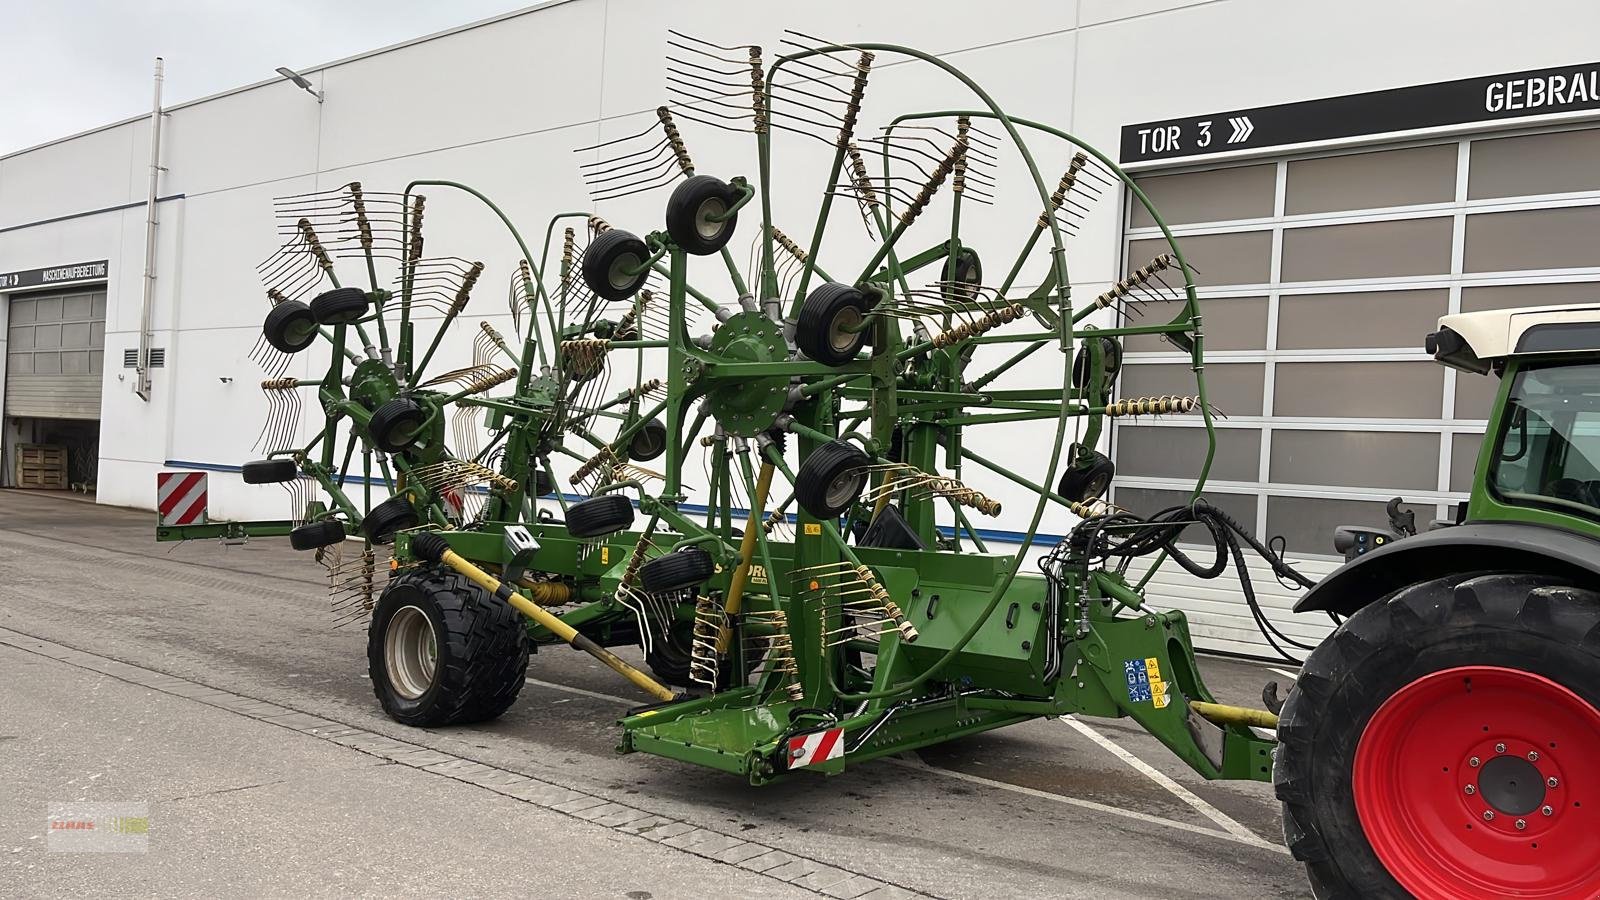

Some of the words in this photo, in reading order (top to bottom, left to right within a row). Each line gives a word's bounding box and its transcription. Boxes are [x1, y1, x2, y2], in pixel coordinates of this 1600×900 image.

[1138, 125, 1181, 154] TOR
[1196, 121, 1213, 148] 3
[42, 263, 105, 282] MASCHINENAUFBEREITUNG
